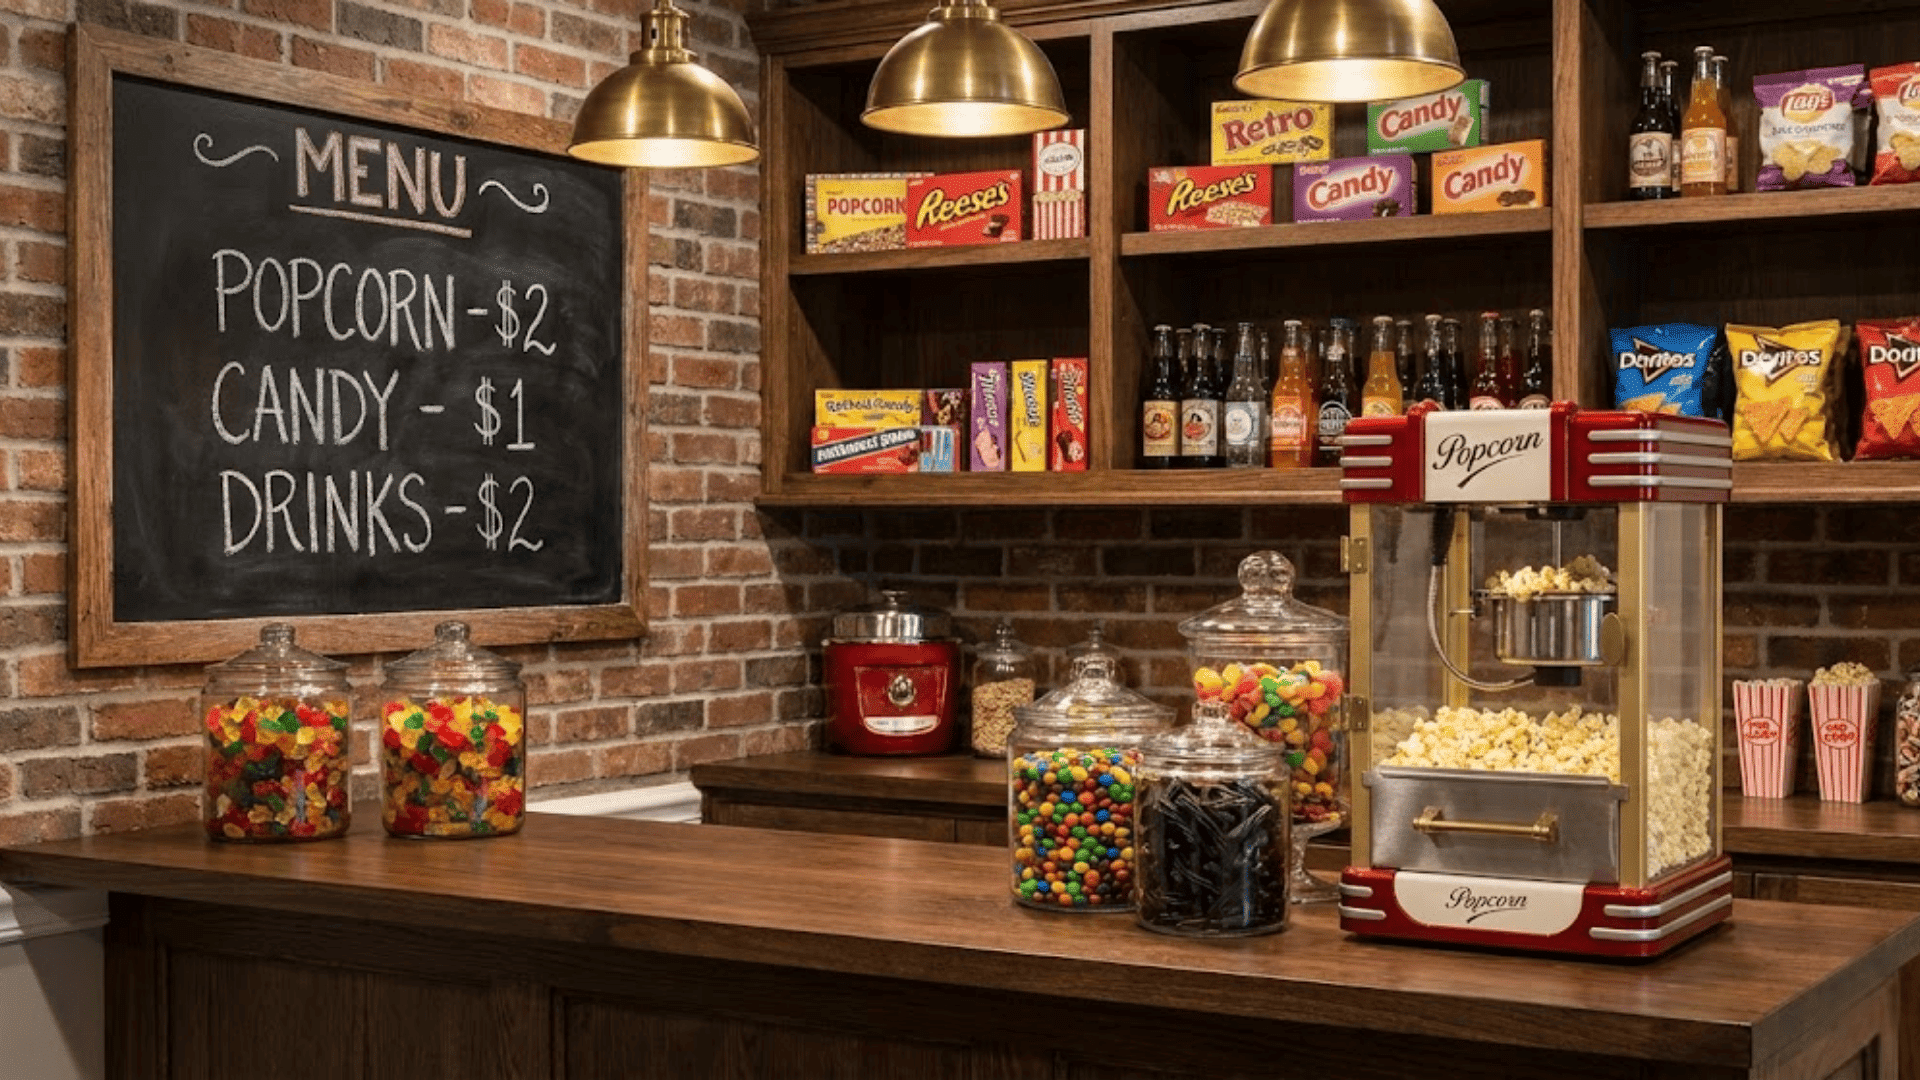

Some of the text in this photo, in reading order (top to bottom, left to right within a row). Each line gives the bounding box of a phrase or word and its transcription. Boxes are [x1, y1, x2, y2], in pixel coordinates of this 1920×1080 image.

[1222, 108, 1314, 151] Retro
[1380, 94, 1463, 138] Candy
[294, 127, 468, 218] MENU
[1308, 165, 1394, 209] Candy
[1444, 152, 1524, 200] Candy
[212, 249, 455, 351] POPCORN
[495, 280, 556, 355] $2
[1619, 352, 1696, 370] Doritos
[1741, 350, 1822, 369] Doritos
[211, 361, 399, 451] CANDY
[474, 376, 534, 451] $1
[1432, 431, 1544, 472] Popcorn
[220, 469, 432, 558] DRINKS
[475, 473, 543, 551] $2
[1445, 886, 1529, 913] Popcorn
